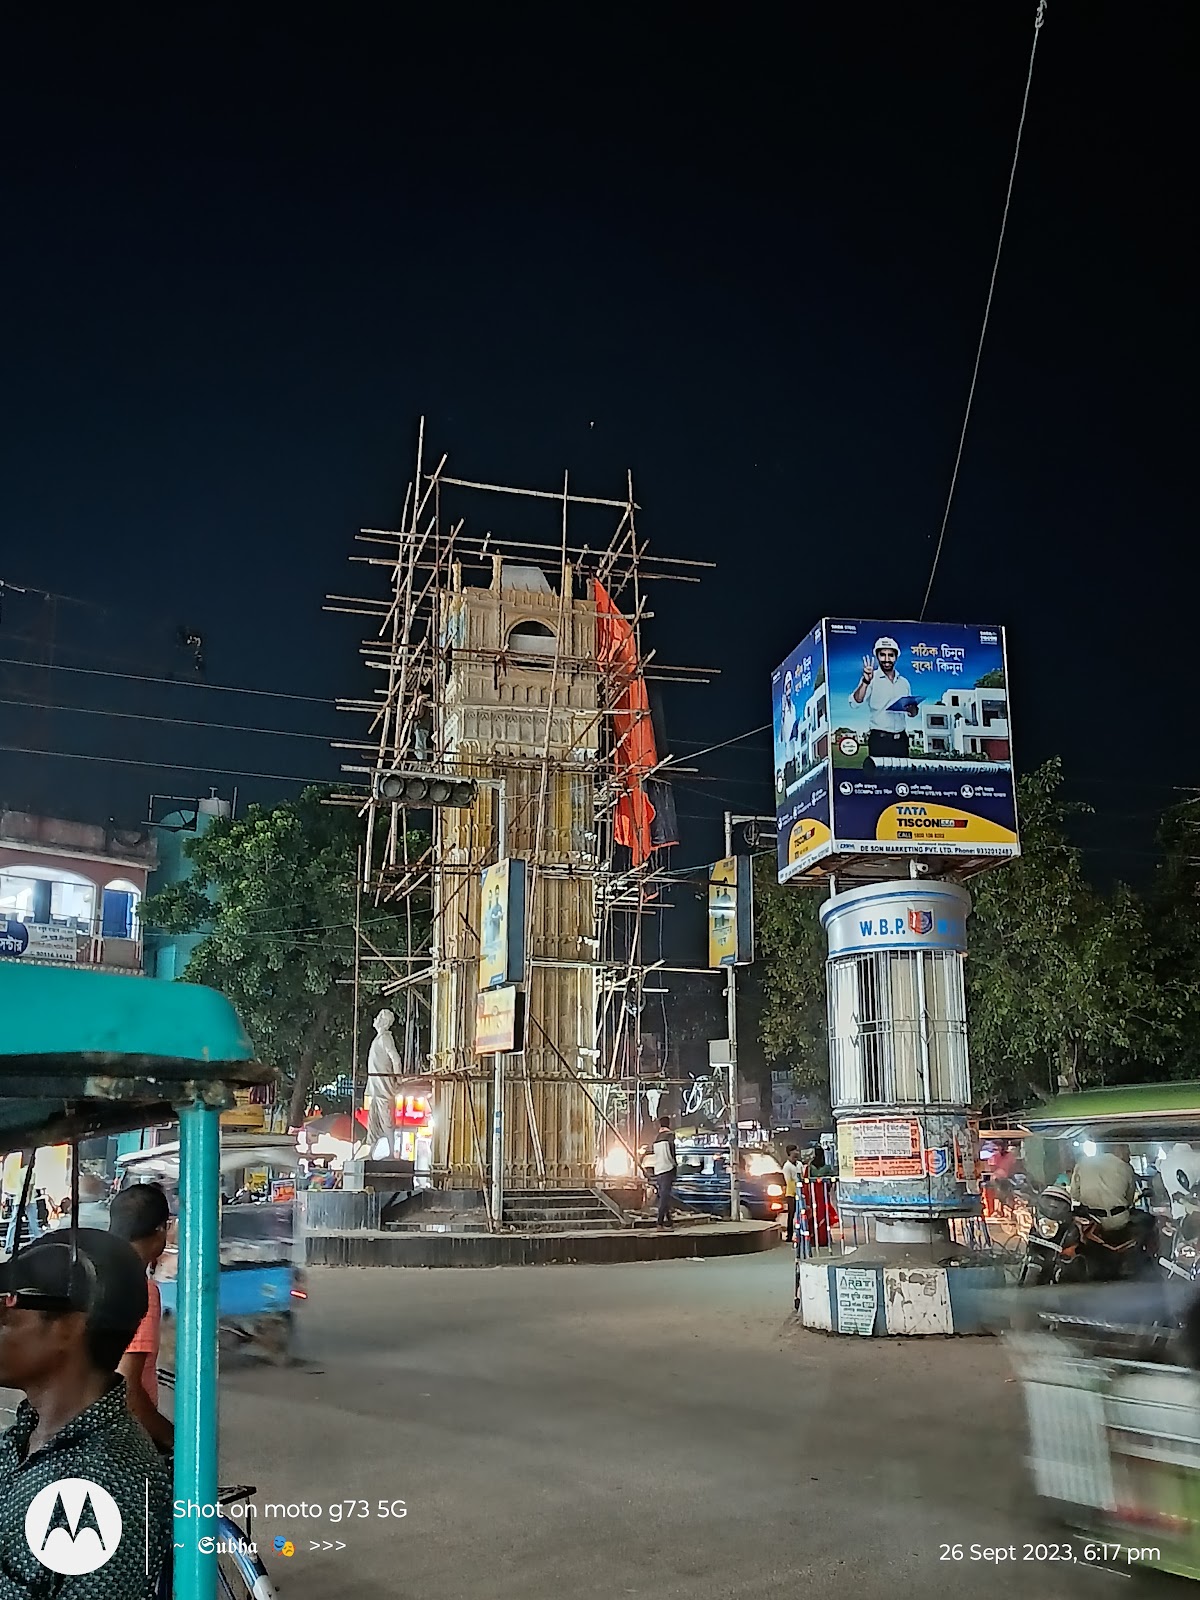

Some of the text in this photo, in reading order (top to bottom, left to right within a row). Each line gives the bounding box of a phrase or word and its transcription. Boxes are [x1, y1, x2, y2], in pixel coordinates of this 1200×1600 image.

[910, 642, 965, 661] সঠিক চিনুন
[910, 658, 963, 676] বুঝে কিনুন
[896, 806, 927, 816] TATA
[896, 818, 940, 828] TISCON
